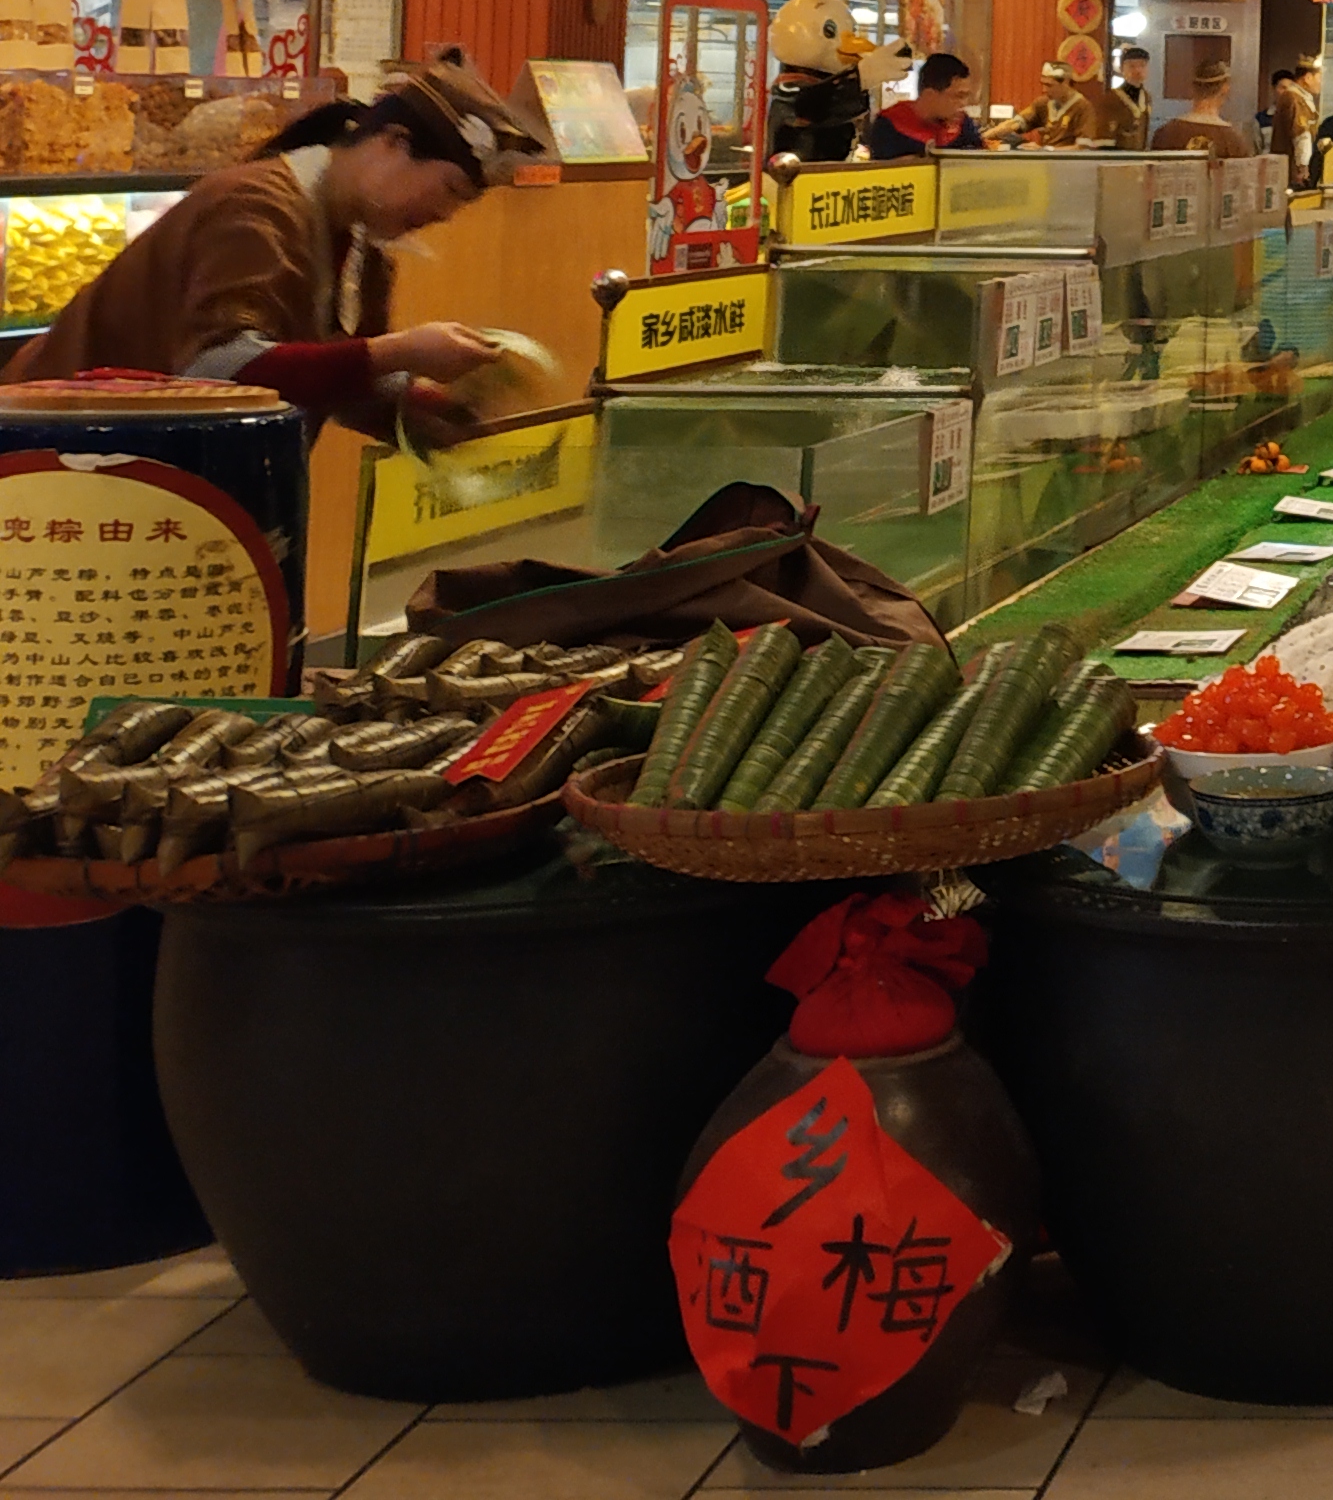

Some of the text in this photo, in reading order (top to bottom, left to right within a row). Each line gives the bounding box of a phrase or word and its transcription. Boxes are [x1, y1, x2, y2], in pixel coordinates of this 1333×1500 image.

[689, 1212, 957, 1344] 酒 梅
[748, 1353, 841, 1433] 下
